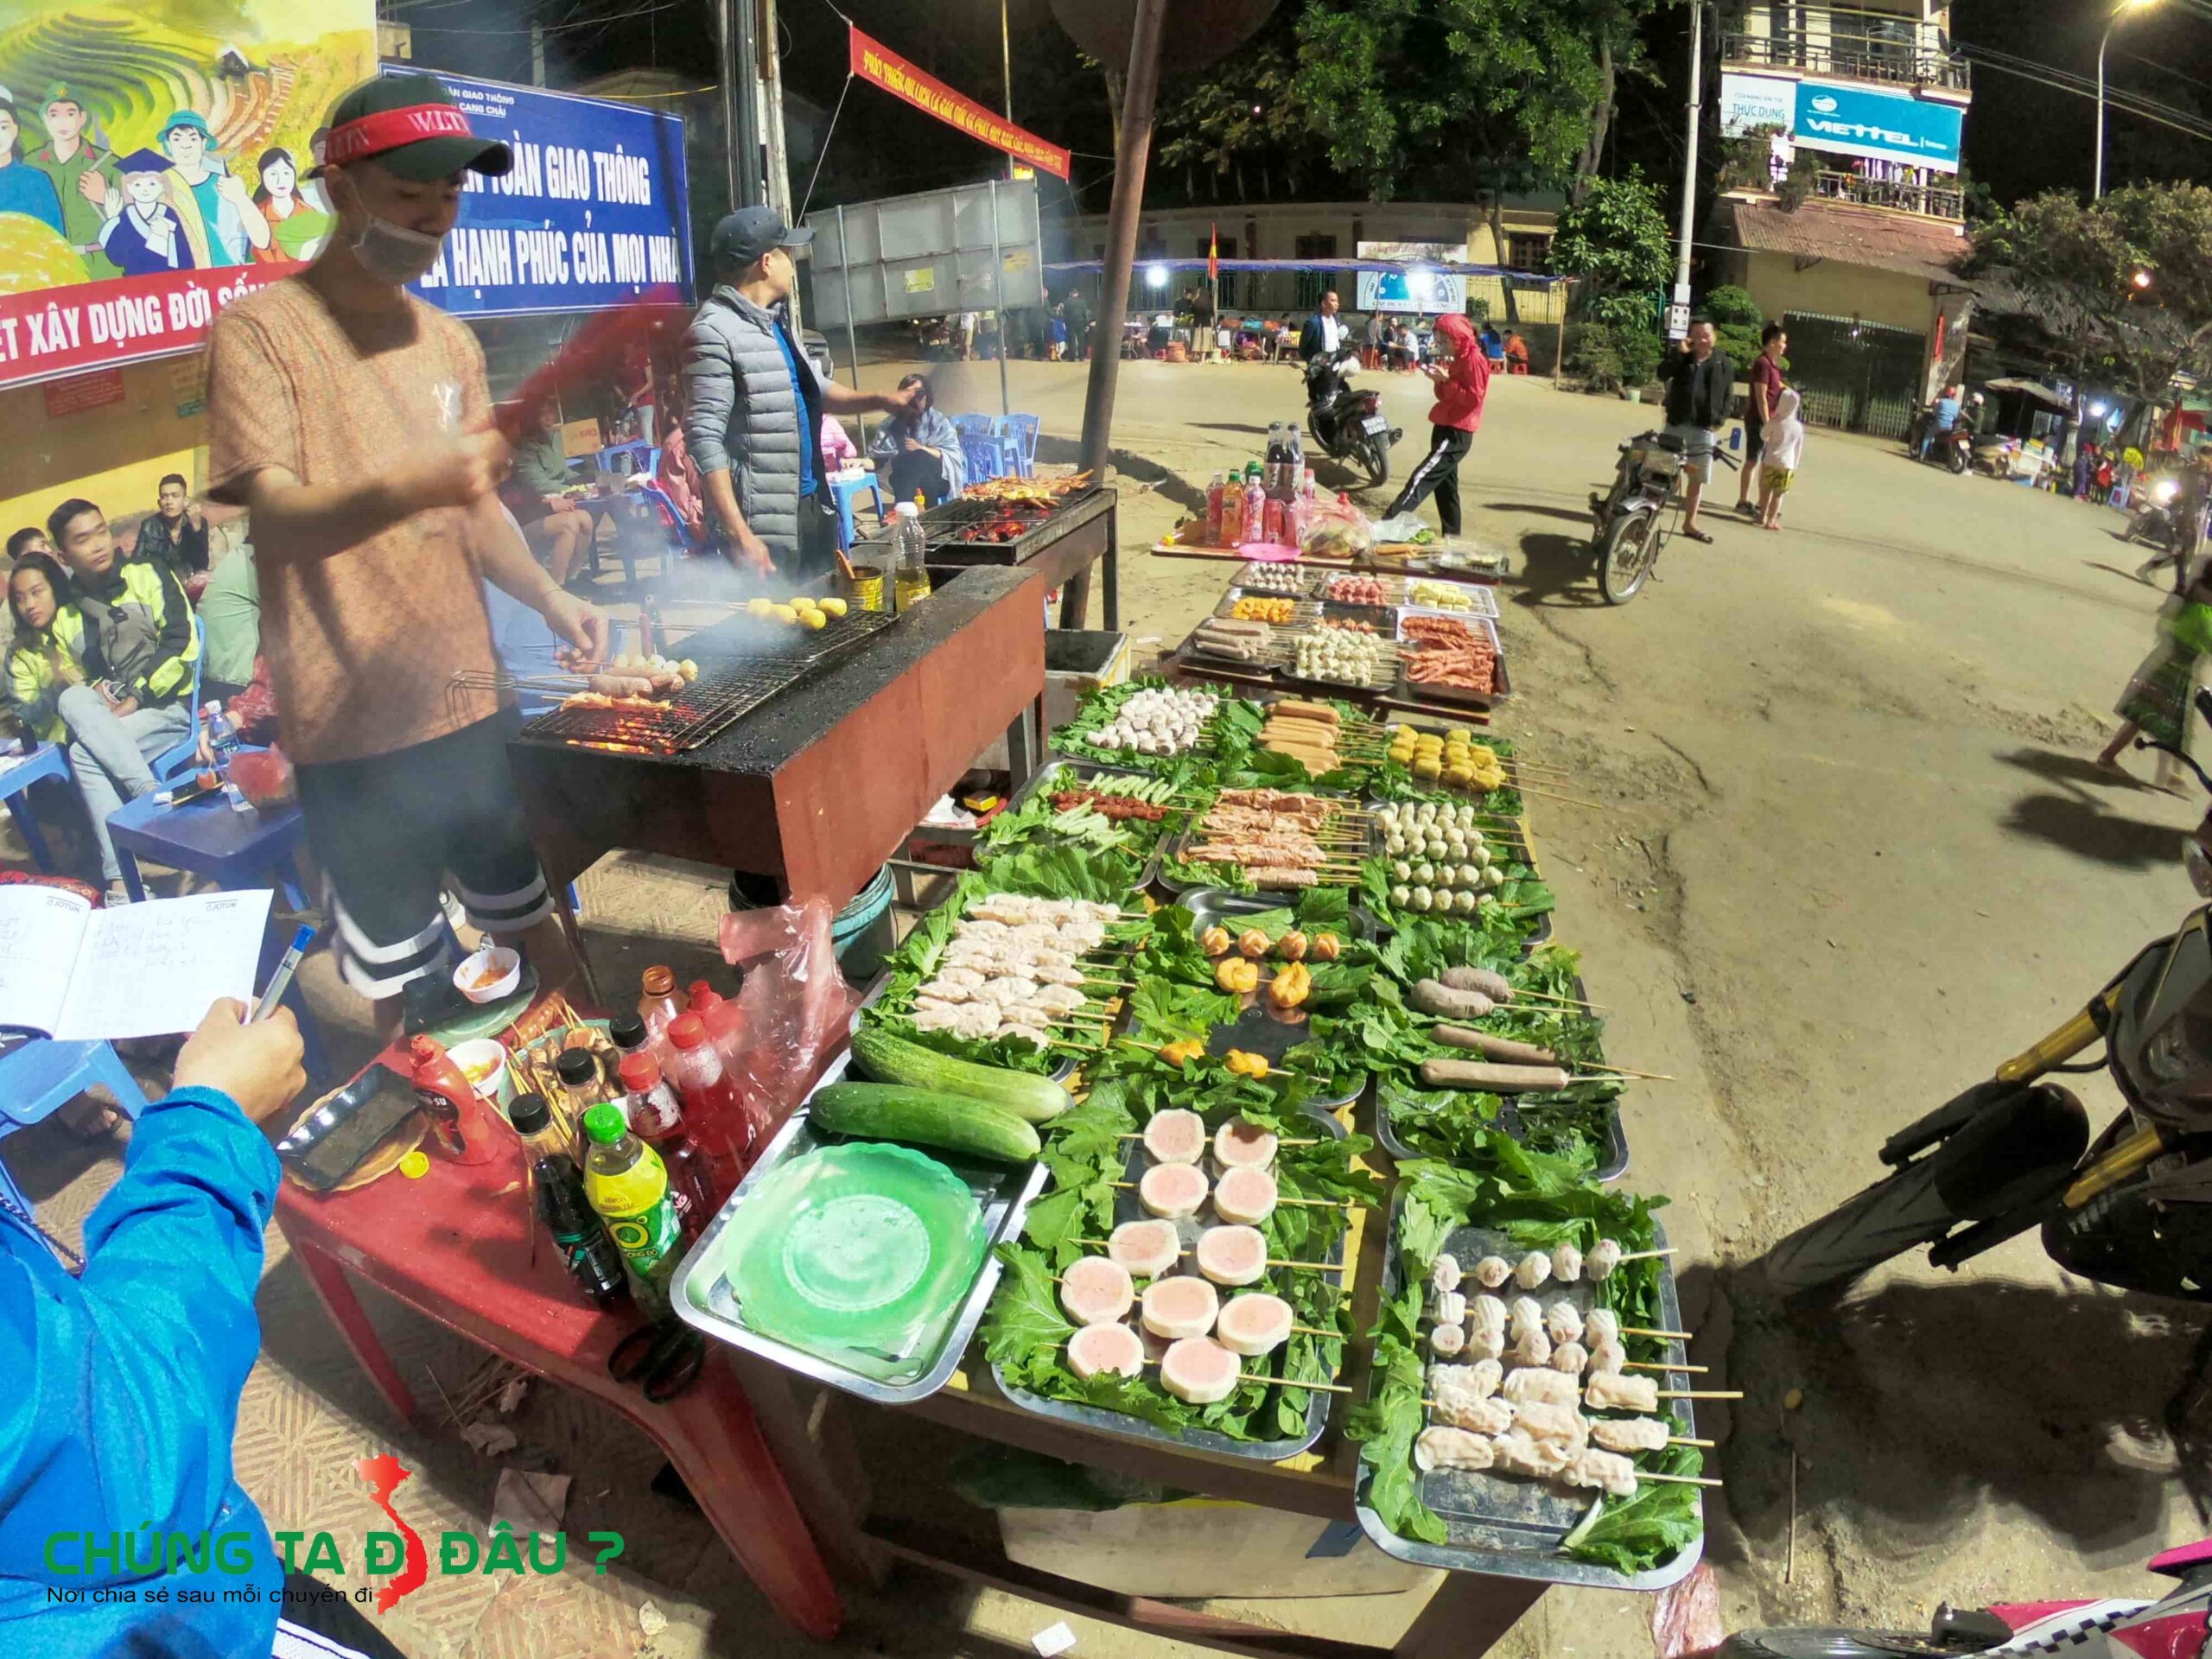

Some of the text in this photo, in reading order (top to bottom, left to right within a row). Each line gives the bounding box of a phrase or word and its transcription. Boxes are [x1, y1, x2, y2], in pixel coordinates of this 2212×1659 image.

[458, 102, 484, 113] CANG
[461, 89, 484, 101] GIAO
[485, 92, 515, 105] THÔNG
[545, 145, 591, 200] GIAO
[593, 143, 651, 206] THÔNG
[451, 228, 513, 300] HẠNH
[515, 219, 569, 285] PHÚC
[571, 210, 611, 284] CỦA
[612, 232, 647, 295] MỌI
[648, 226, 683, 283] NHÀ
[25, 301, 80, 356] XÂY
[88, 295, 164, 348] DỰNG
[168, 281, 213, 332] ĐỜI
